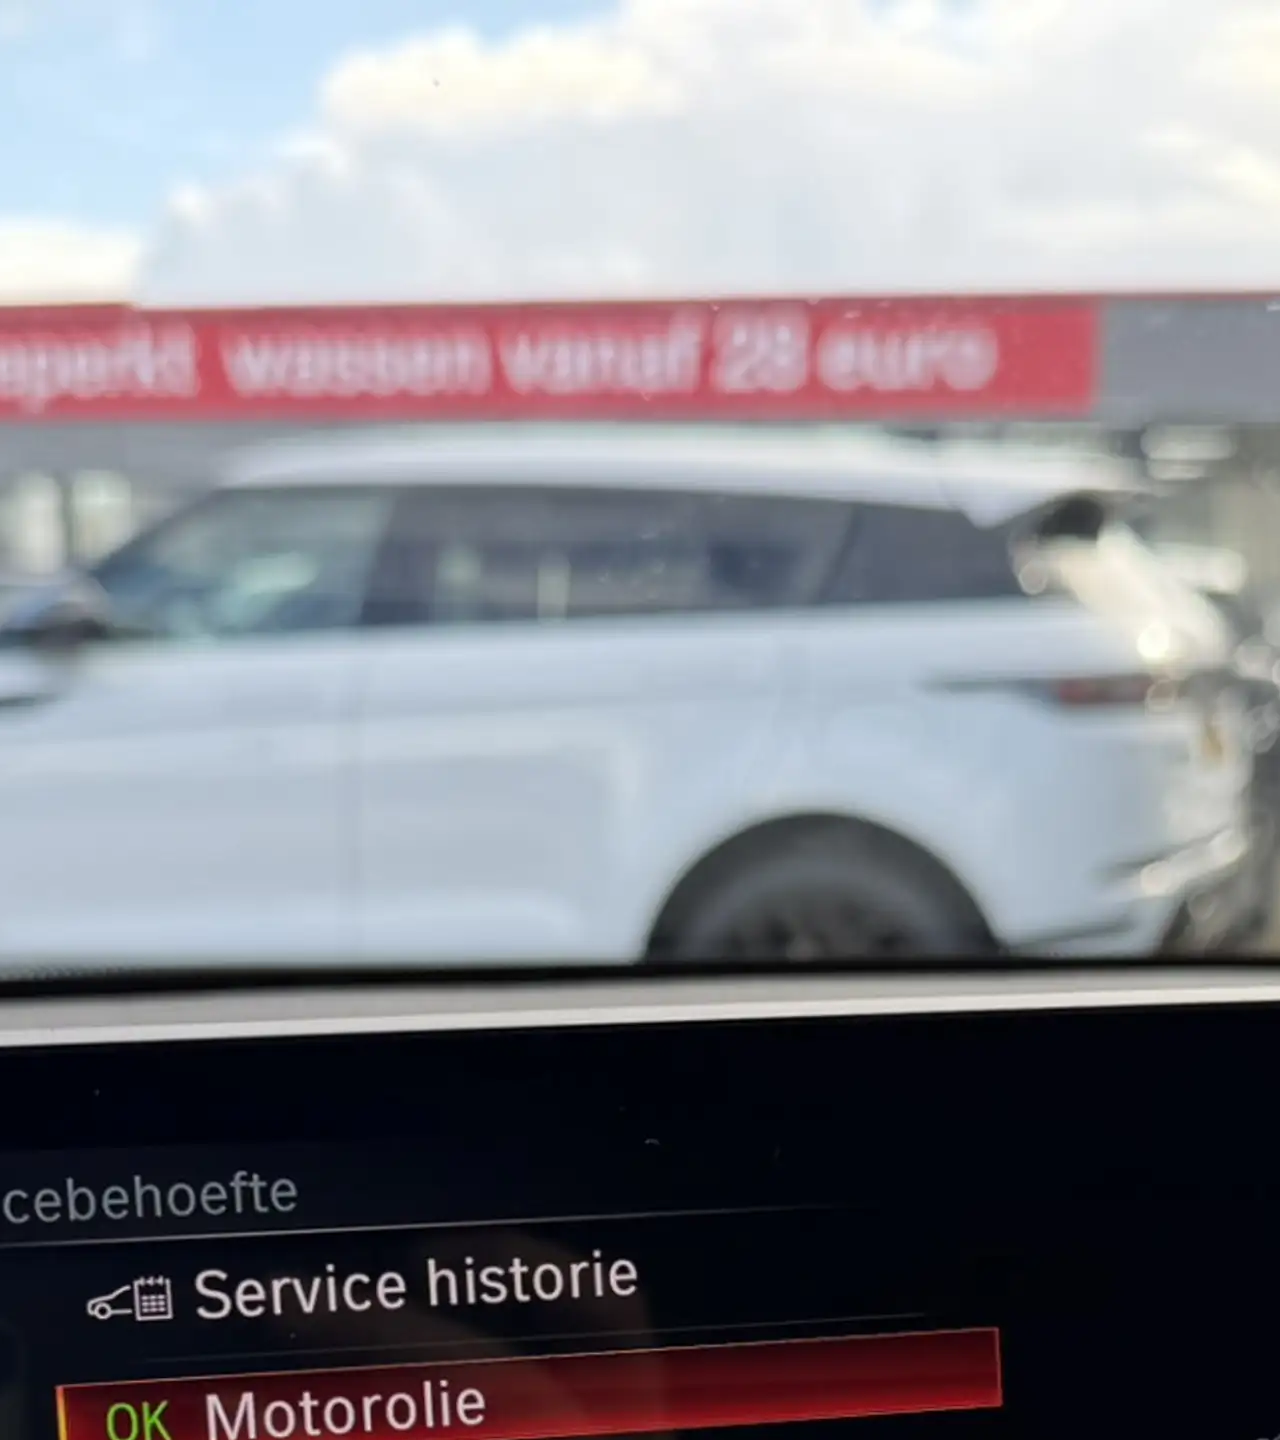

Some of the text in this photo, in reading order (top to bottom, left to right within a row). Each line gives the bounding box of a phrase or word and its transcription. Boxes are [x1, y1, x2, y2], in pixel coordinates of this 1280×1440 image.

[818, 322, 997, 391] euro
[195, 1249, 638, 1319] Service historie
